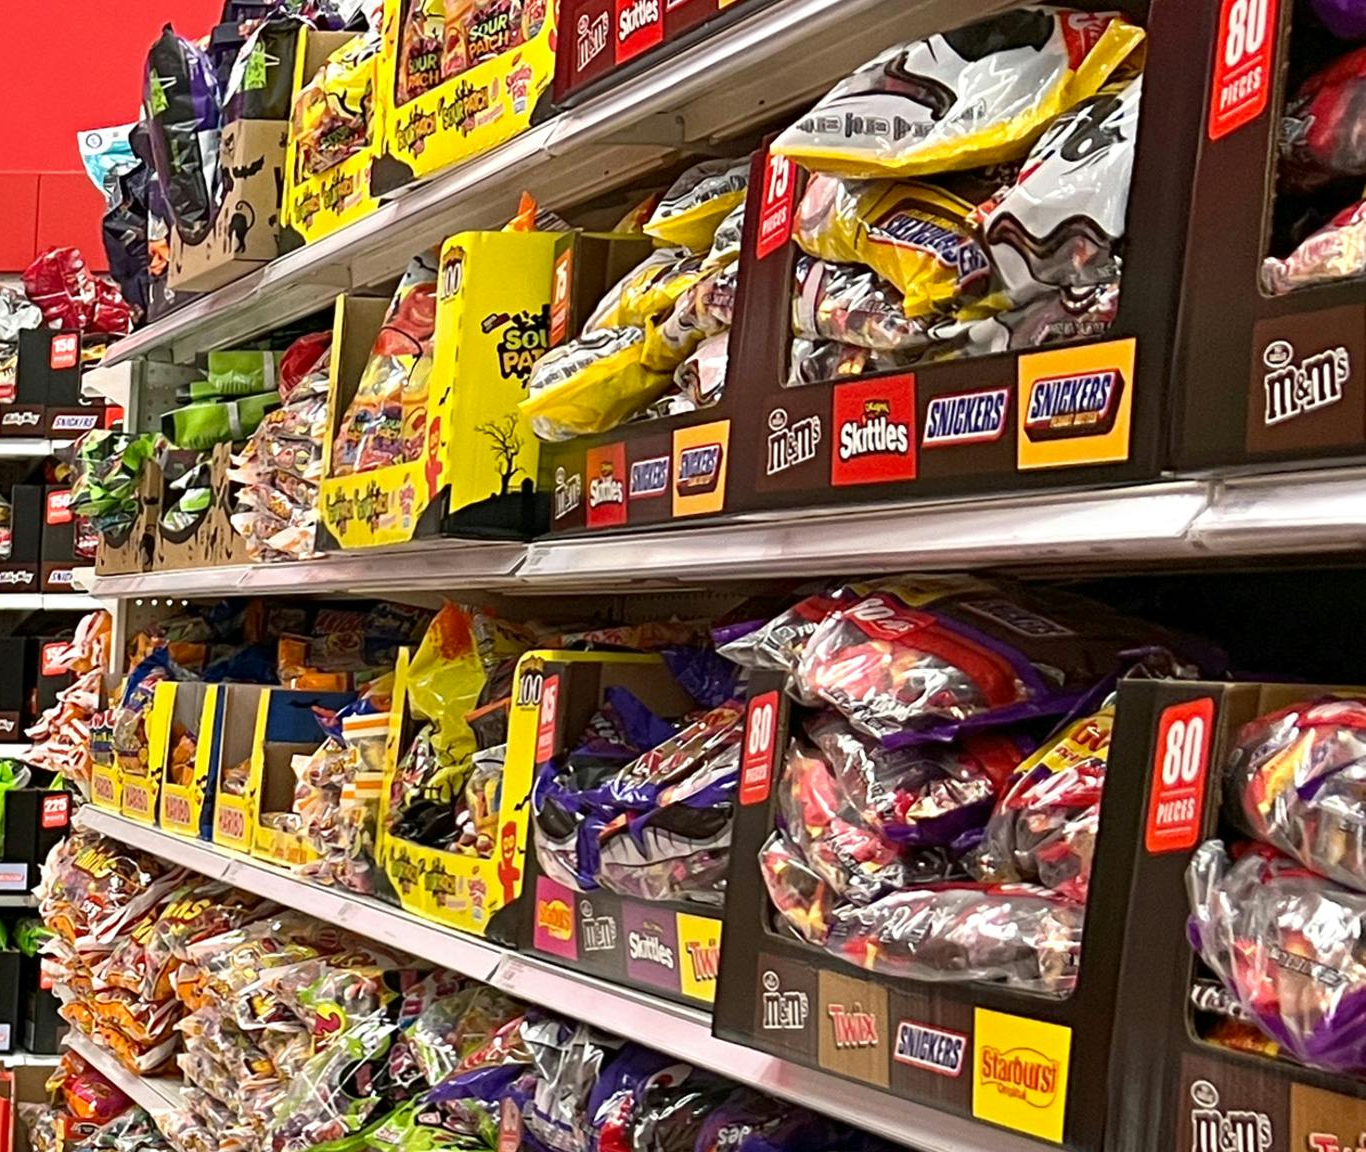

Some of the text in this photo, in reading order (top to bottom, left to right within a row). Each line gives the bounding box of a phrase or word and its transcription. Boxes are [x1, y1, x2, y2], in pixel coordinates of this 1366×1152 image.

[619, 0, 659, 44] Skittles
[1225, 0, 1265, 68] 80
[1220, 65, 1262, 110] PIECES
[926, 394, 1005, 439] SNICKERS
[1030, 374, 1112, 419] SNICKERS
[839, 412, 908, 461] Skittles
[517, 674, 543, 706] 100
[748, 702, 771, 754] 80
[1161, 716, 1202, 783] 80
[44, 799, 68, 812] 225
[1154, 798, 1197, 824] PIECES
[629, 931, 675, 970] Skittles
[898, 1025, 963, 1070] SNICKERS
[982, 1046, 1060, 1094] Starburst
